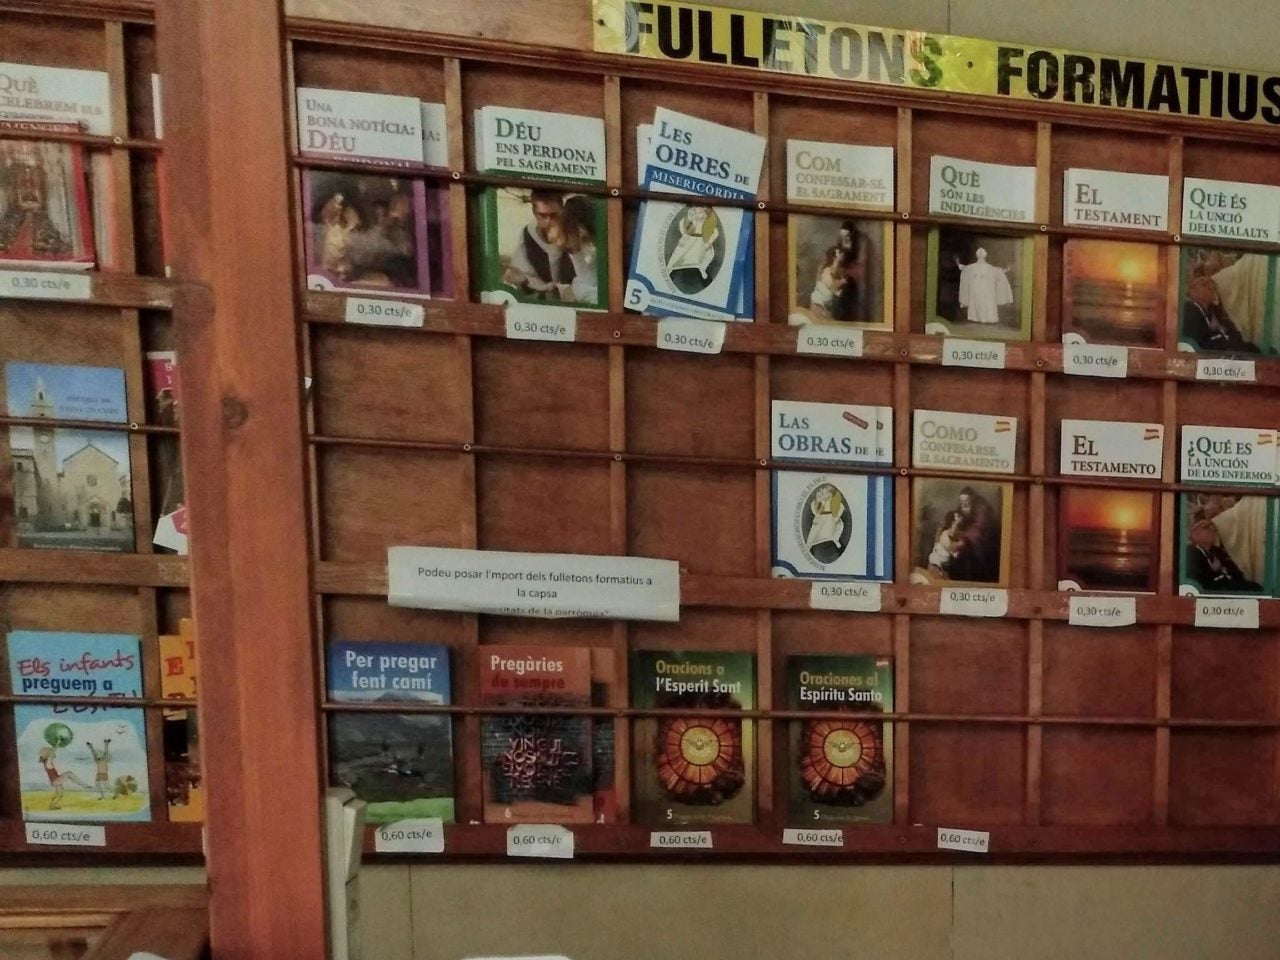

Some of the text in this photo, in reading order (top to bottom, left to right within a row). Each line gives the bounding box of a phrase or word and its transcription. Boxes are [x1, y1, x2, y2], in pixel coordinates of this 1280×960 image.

[625, 2, 943, 87] FULLETONS
[306, 99, 332, 112] UNA
[307, 115, 346, 129] BONA
[350, 118, 415, 136] NOTÍCIA:
[495, 118, 541, 141] DÉU
[659, 121, 693, 145] LES
[307, 129, 356, 151] DÉU
[496, 142, 596, 163] ENS PERDONA
[795, 150, 842, 172] COM
[496, 156, 597, 176] PEL SAGRAMENT
[655, 144, 750, 185] OBRES DE
[940, 164, 981, 189] QUÈ
[812, 187, 887, 203] SAGRAMENT
[966, 192, 985, 204] LES
[1075, 183, 1103, 205] EL
[1189, 187, 1247, 210] QUÈ ÉS
[1074, 208, 1162, 227] TESTAMENT
[1189, 210, 1243, 224] LA UNCIÓ
[1188, 222, 1217, 234] DELS
[1218, 225, 1269, 240] MALALTS
[630, 288, 642, 305] 5
[779, 413, 809, 429] LAS
[920, 420, 978, 441] COMO
[778, 434, 851, 455] OBRAS
[855, 446, 869, 456] DE
[1072, 435, 1098, 456] EL
[1187, 437, 1252, 457] ¿QUÉ ES
[1071, 460, 1156, 475] TESTAMENTO
[1188, 457, 1249, 469] LA UNCIÓN
[1187, 469, 1201, 478] DE
[1202, 469, 1220, 479] LOS
[1221, 469, 1272, 481] ENFERMOS
[418, 567, 451, 578] Podeu
[454, 570, 482, 581] posar
[526, 571, 546, 581] dels
[549, 572, 593, 583] fulletons
[596, 573, 644, 585] formatius
[647, 577, 653, 585] a
[517, 588, 557, 600] la capsa
[17, 649, 134, 677] Els infants
[346, 651, 437, 670] Per pregar
[491, 655, 563, 675] Pregàries
[656, 660, 725, 674] Oracions a
[22, 677, 113, 693] preguem a
[352, 671, 432, 690] fent camí
[491, 676, 509, 689] de
[656, 678, 741, 695] l'Esperit Sant
[800, 672, 878, 686] Oraciones al
[800, 686, 883, 702] Espíritu Santo
[505, 808, 511, 818] 6
[666, 808, 673, 820] 5
[813, 809, 820, 821] 5
